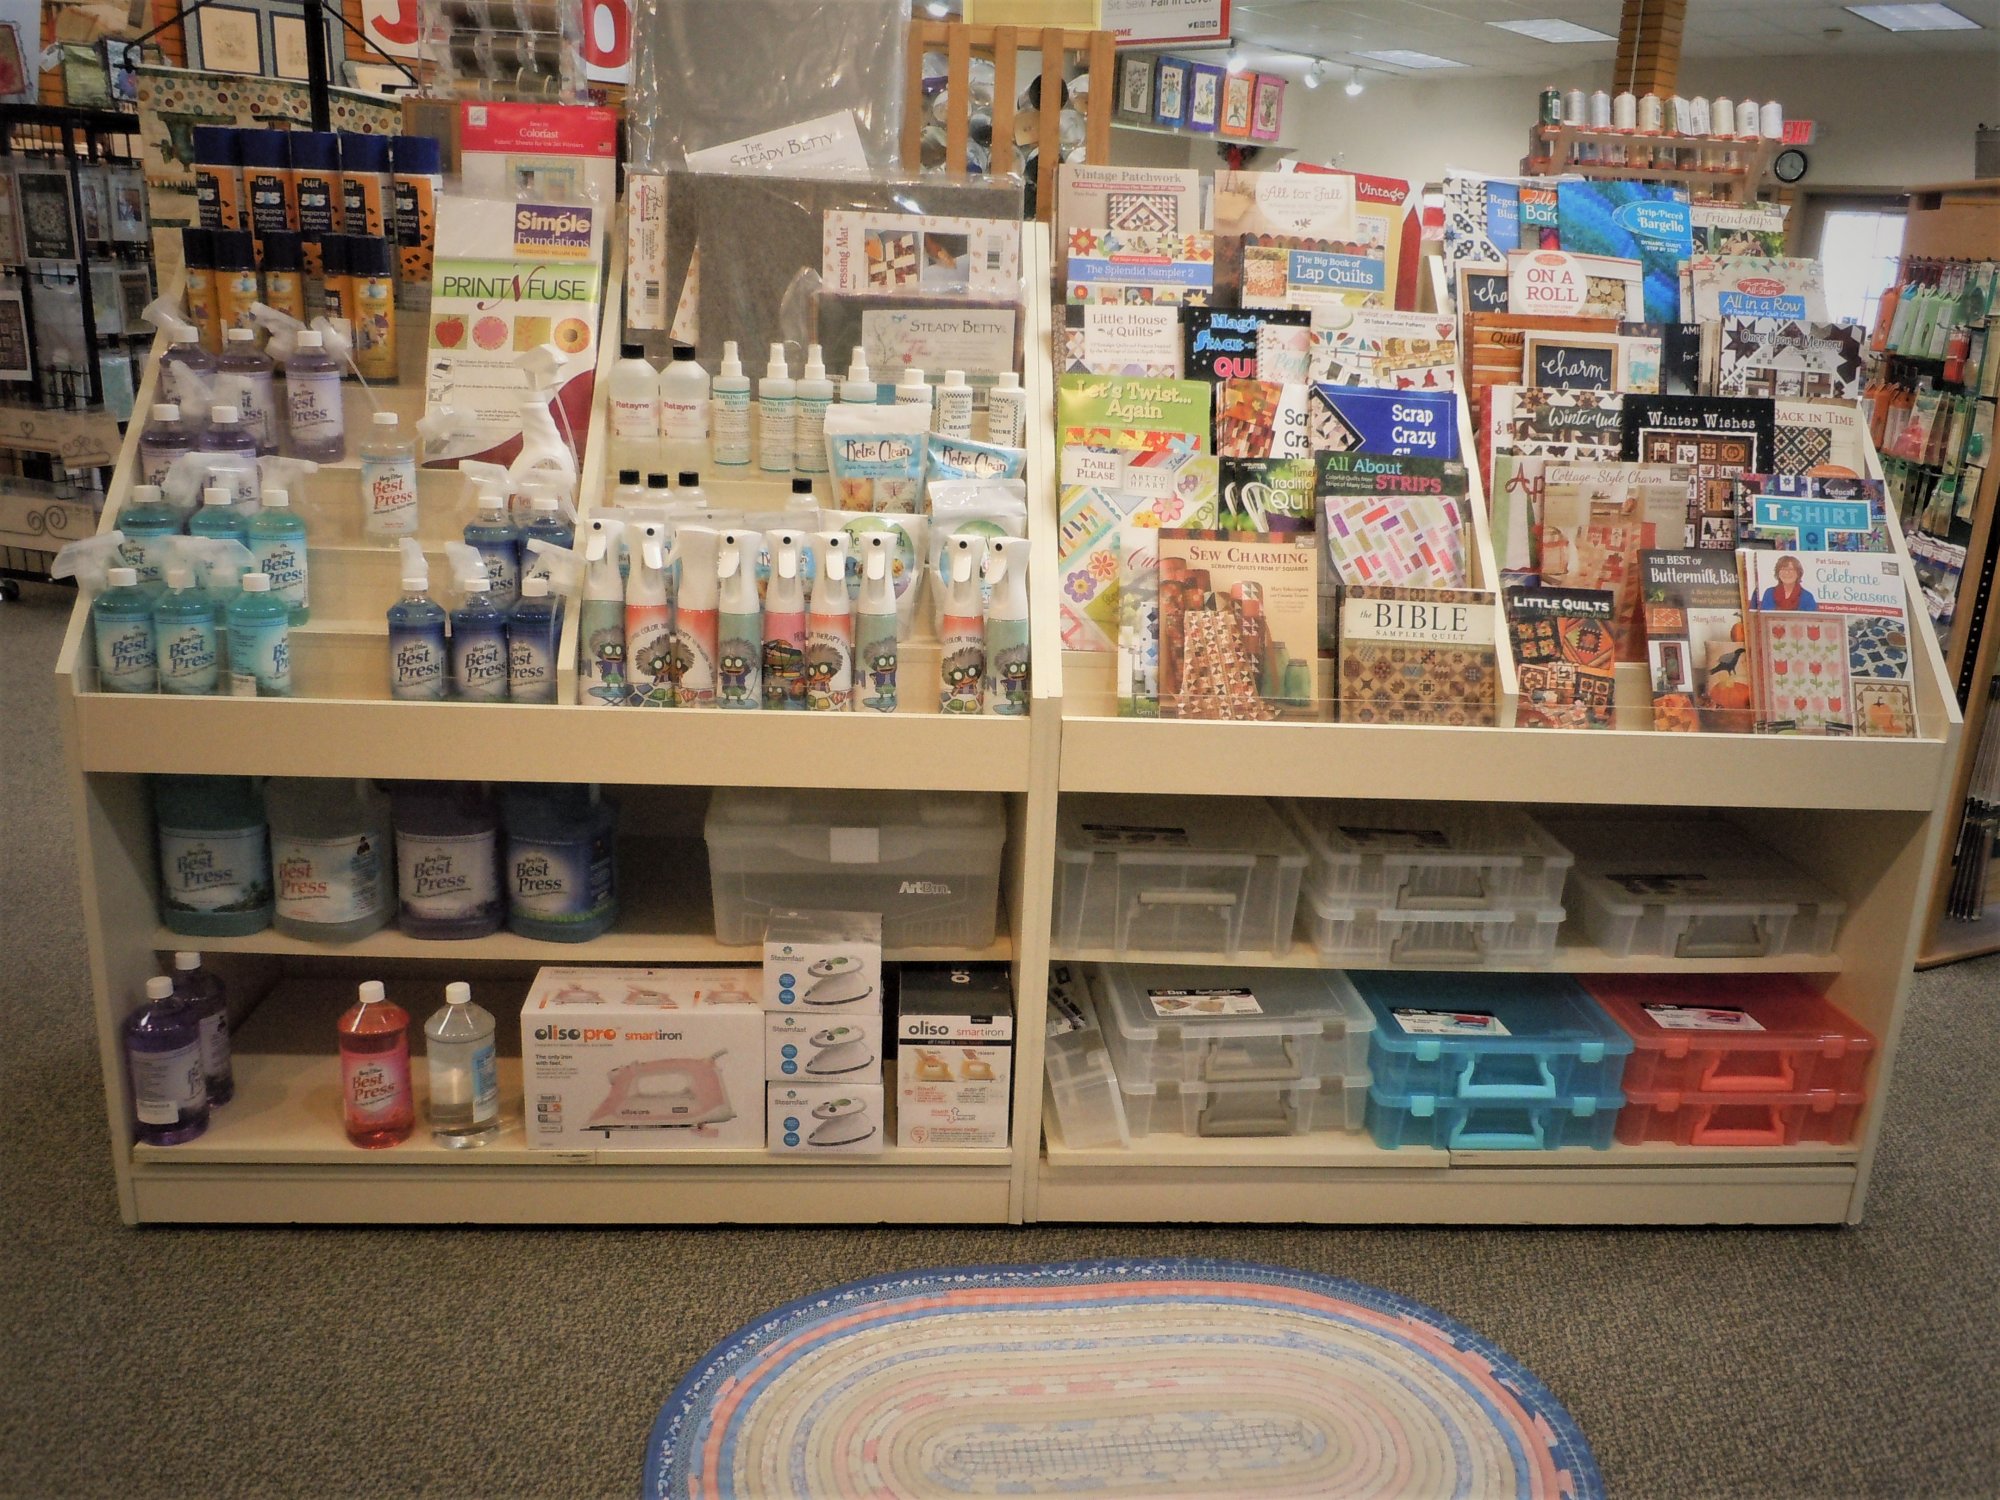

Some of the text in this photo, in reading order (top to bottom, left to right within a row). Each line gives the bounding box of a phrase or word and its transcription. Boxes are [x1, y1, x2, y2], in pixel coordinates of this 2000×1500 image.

[520, 128, 558, 138] Colorfast
[1783, 121, 1812, 144] EXIT
[730, 134, 833, 166] STEADY BETTY
[1074, 169, 1181, 183] Vintage Patchwork
[1359, 182, 1406, 201] Vintage
[1490, 194, 1518, 207] Regen
[1497, 208, 1518, 220] Blue
[1702, 212, 1774, 228] Friendships
[517, 211, 591, 236] Simple
[1638, 217, 1685, 233] Bargello
[517, 232, 590, 248] Foundations
[1296, 255, 1361, 268] The Big Book of
[838, 249, 851, 294] ressing
[1086, 265, 1194, 278] The Splendid Sampler 2
[1296, 266, 1374, 284] Lap Quilts
[1527, 268, 1574, 285] ON A
[443, 276, 586, 300] PRINT FUSE
[1526, 286, 1579, 302] ROLL
[1723, 295, 1802, 312] All in a Row
[910, 319, 1002, 334] STEADY BETTY
[1093, 314, 1168, 326] Little House
[1116, 326, 1154, 338] Quilts
[1740, 329, 1766, 345] Once
[1767, 328, 1792, 348] Upon
[1802, 334, 1844, 351] Memory
[1542, 350, 1609, 382] charm
[1077, 380, 1122, 400] Let's
[616, 400, 650, 412] Retayne
[664, 401, 697, 412] Retayne
[1106, 399, 1163, 423] Again
[1392, 404, 1434, 427] Scrap
[1548, 407, 1624, 429] Winterlude
[1647, 411, 1756, 430] Winter Wishes
[1808, 413, 1821, 424] IN
[1825, 410, 1855, 427] TIME
[1392, 426, 1437, 449] Crazy
[845, 439, 911, 463] Retro Clean
[942, 445, 1007, 474] Retro Clean
[1081, 458, 1116, 471] TABLE
[1326, 457, 1403, 475] All About
[1077, 468, 1116, 481] PLEASE
[1130, 473, 1149, 482] ART
[1551, 469, 1625, 485] Cottage-Style
[372, 478, 405, 494] Best
[1130, 481, 1166, 489] HEART
[1271, 477, 1315, 491] Traditio
[1376, 474, 1442, 494] STRIPS
[373, 491, 414, 509] Press
[1189, 545, 1309, 565] SEW CHARMING
[1649, 557, 1664, 565] THE
[1666, 555, 1691, 565] BEST
[262, 555, 296, 573] Best
[1211, 563, 1236, 571] SCRAPPY
[1237, 564, 1257, 572] QUILTS
[1651, 567, 1719, 585] Buttermilk
[1816, 568, 1880, 586] Celebrate
[1817, 584, 1898, 605] the Seasons
[1513, 596, 1610, 613] LITTLE QUILTS
[1360, 602, 1468, 632] the BIBLE
[1376, 629, 1465, 641] SAMPLER QUILT
[111, 637, 149, 657] Best
[168, 638, 205, 659] Best
[115, 651, 157, 672] Press
[171, 652, 215, 674] Press
[397, 651, 431, 668] Best
[465, 650, 500, 668] Best
[398, 662, 440, 682] Press
[467, 662, 508, 683] Press
[177, 853, 215, 871] Best
[414, 860, 453, 879] Best
[516, 861, 549, 878] Best
[184, 867, 233, 888] Press
[279, 863, 313, 879] Best
[281, 881, 328, 895] Press
[416, 876, 466, 893] Press
[518, 877, 562, 893] Press
[770, 954, 805, 962] Steamfast
[534, 1025, 683, 1043] oliso pro smartiron
[908, 1020, 949, 1036] oliso
[352, 1072, 385, 1089] Best
[354, 1082, 395, 1101] Press
